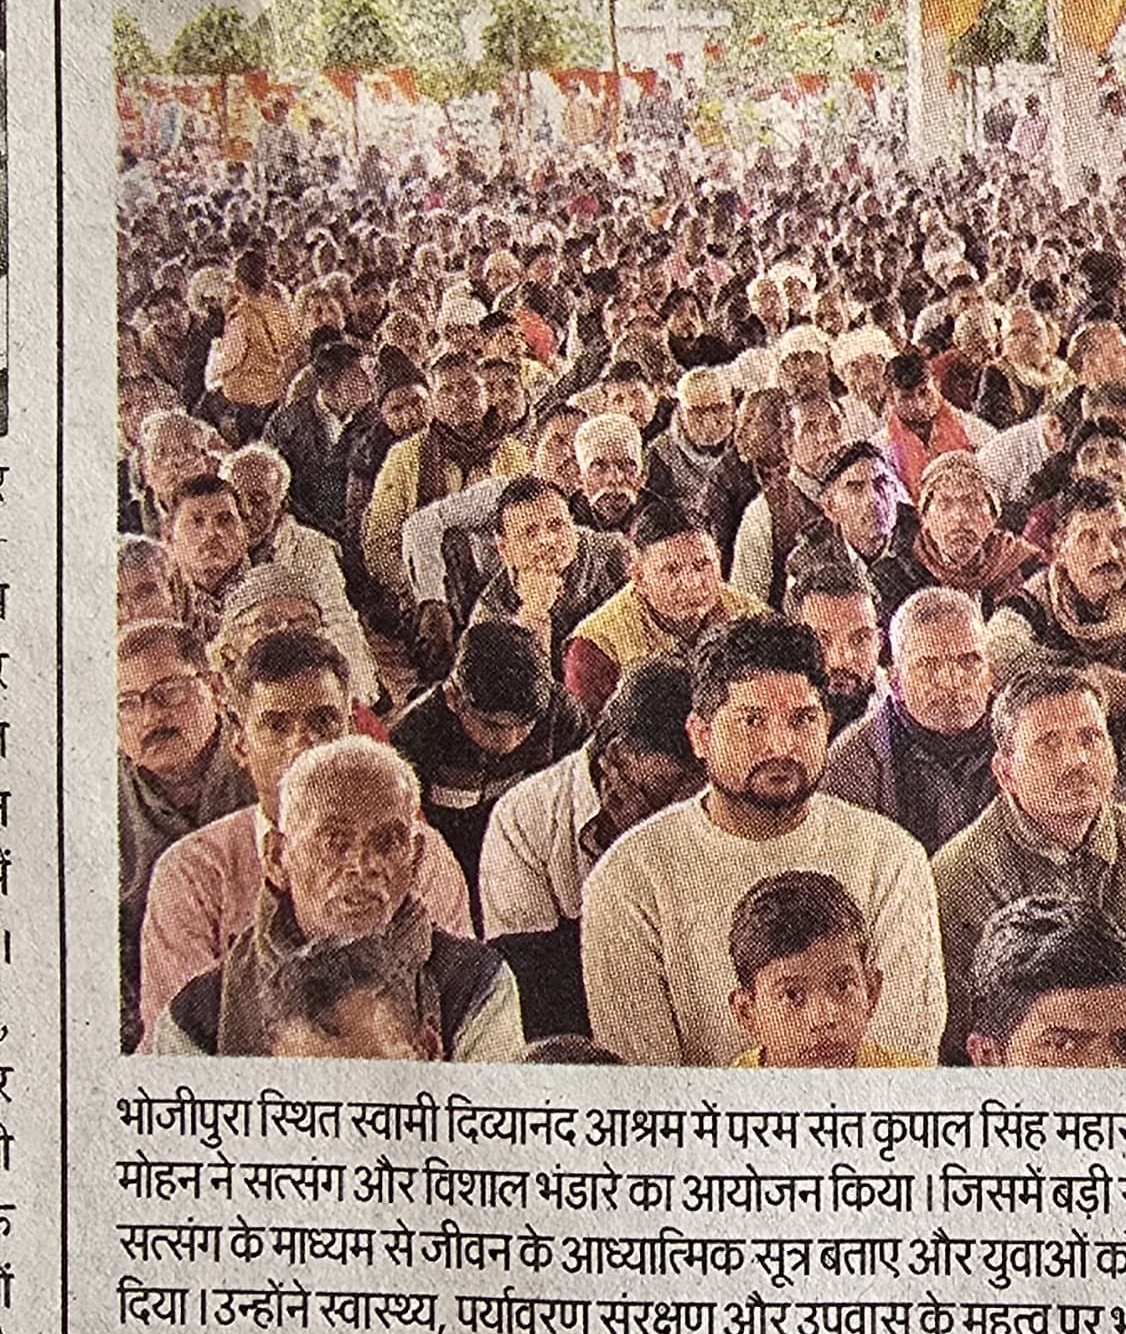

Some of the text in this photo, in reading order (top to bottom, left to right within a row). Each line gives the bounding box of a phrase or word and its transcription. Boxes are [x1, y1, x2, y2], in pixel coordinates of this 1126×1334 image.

[116, 1087, 253, 1149] भोजीपुरा
[257, 1090, 344, 1142] स्थित
[347, 1091, 440, 1142] स्वामी
[445, 1094, 579, 1147] दिव्यानंद
[586, 1109, 687, 1148] आश्रम
[691, 1100, 721, 1148] में
[725, 1112, 800, 1148] परम
[804, 1103, 866, 1148] संत
[871, 1111, 974, 1162] कृपाल
[979, 1099, 1049, 1151] सिंह
